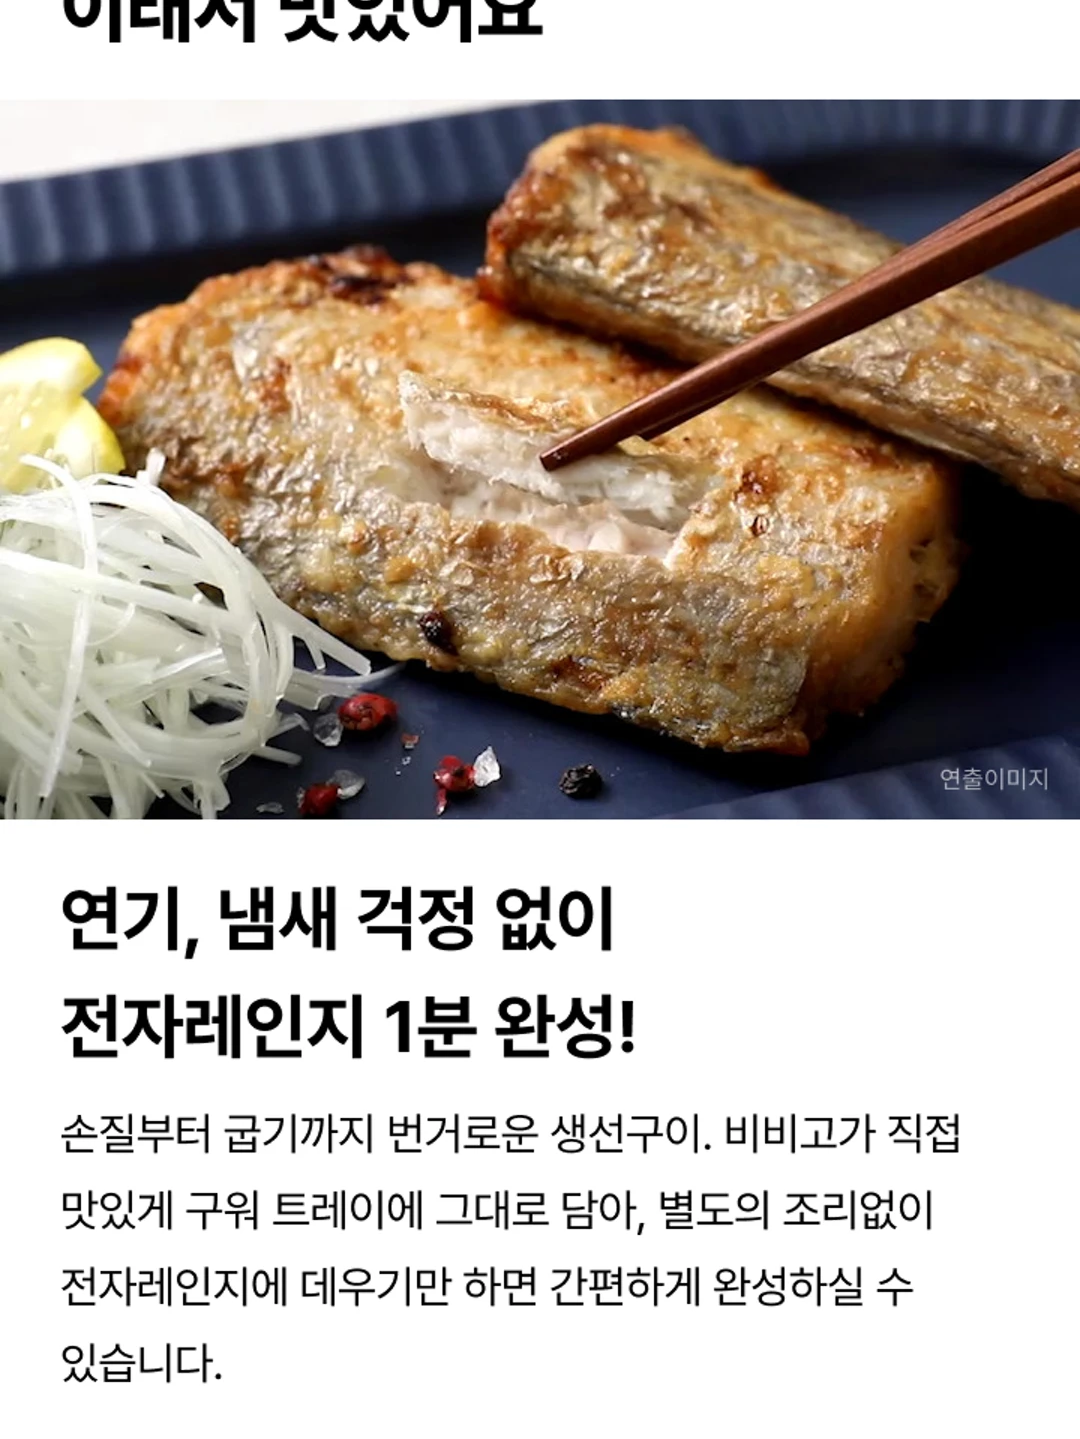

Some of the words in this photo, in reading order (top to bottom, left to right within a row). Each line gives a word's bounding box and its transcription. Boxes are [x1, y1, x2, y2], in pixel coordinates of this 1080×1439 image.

[62, 885, 199, 960] 연기,
[220, 885, 336, 951] 냄새
[357, 885, 474, 952] 걱정
[496, 885, 612, 952] 없이
[61, 993, 363, 1059] 전자레인지
[386, 995, 478, 1058] 1분
[494, 993, 634, 1059] 완성!
[60, 1113, 210, 1154] 손질부터
[224, 1113, 372, 1154] 굽기까지
[389, 1113, 539, 1154] 번거로운
[551, 1113, 711, 1154] 생선구이.
[726, 1113, 877, 1154] 비비고가
[888, 1113, 959, 1154] 직접
[62, 1189, 172, 1231] 맛있게
[185, 1189, 258, 1231] 구워
[272, 1189, 422, 1231] 트레이에
[435, 1189, 550, 1231] 그대로
[562, 1189, 645, 1236] 담아,
[660, 1189, 769, 1231] 별도의
[783, 1189, 932, 1231] 조리없이
[61, 1266, 287, 1307] 전자레인지에
[301, 1266, 453, 1307] 데우기만
[463, 1266, 537, 1307] 하면
[550, 1266, 700, 1307] 간편하게
[713, 1266, 863, 1307] 완성하실
[876, 1267, 914, 1307] 수
[62, 1342, 222, 1384] 있습니다.
